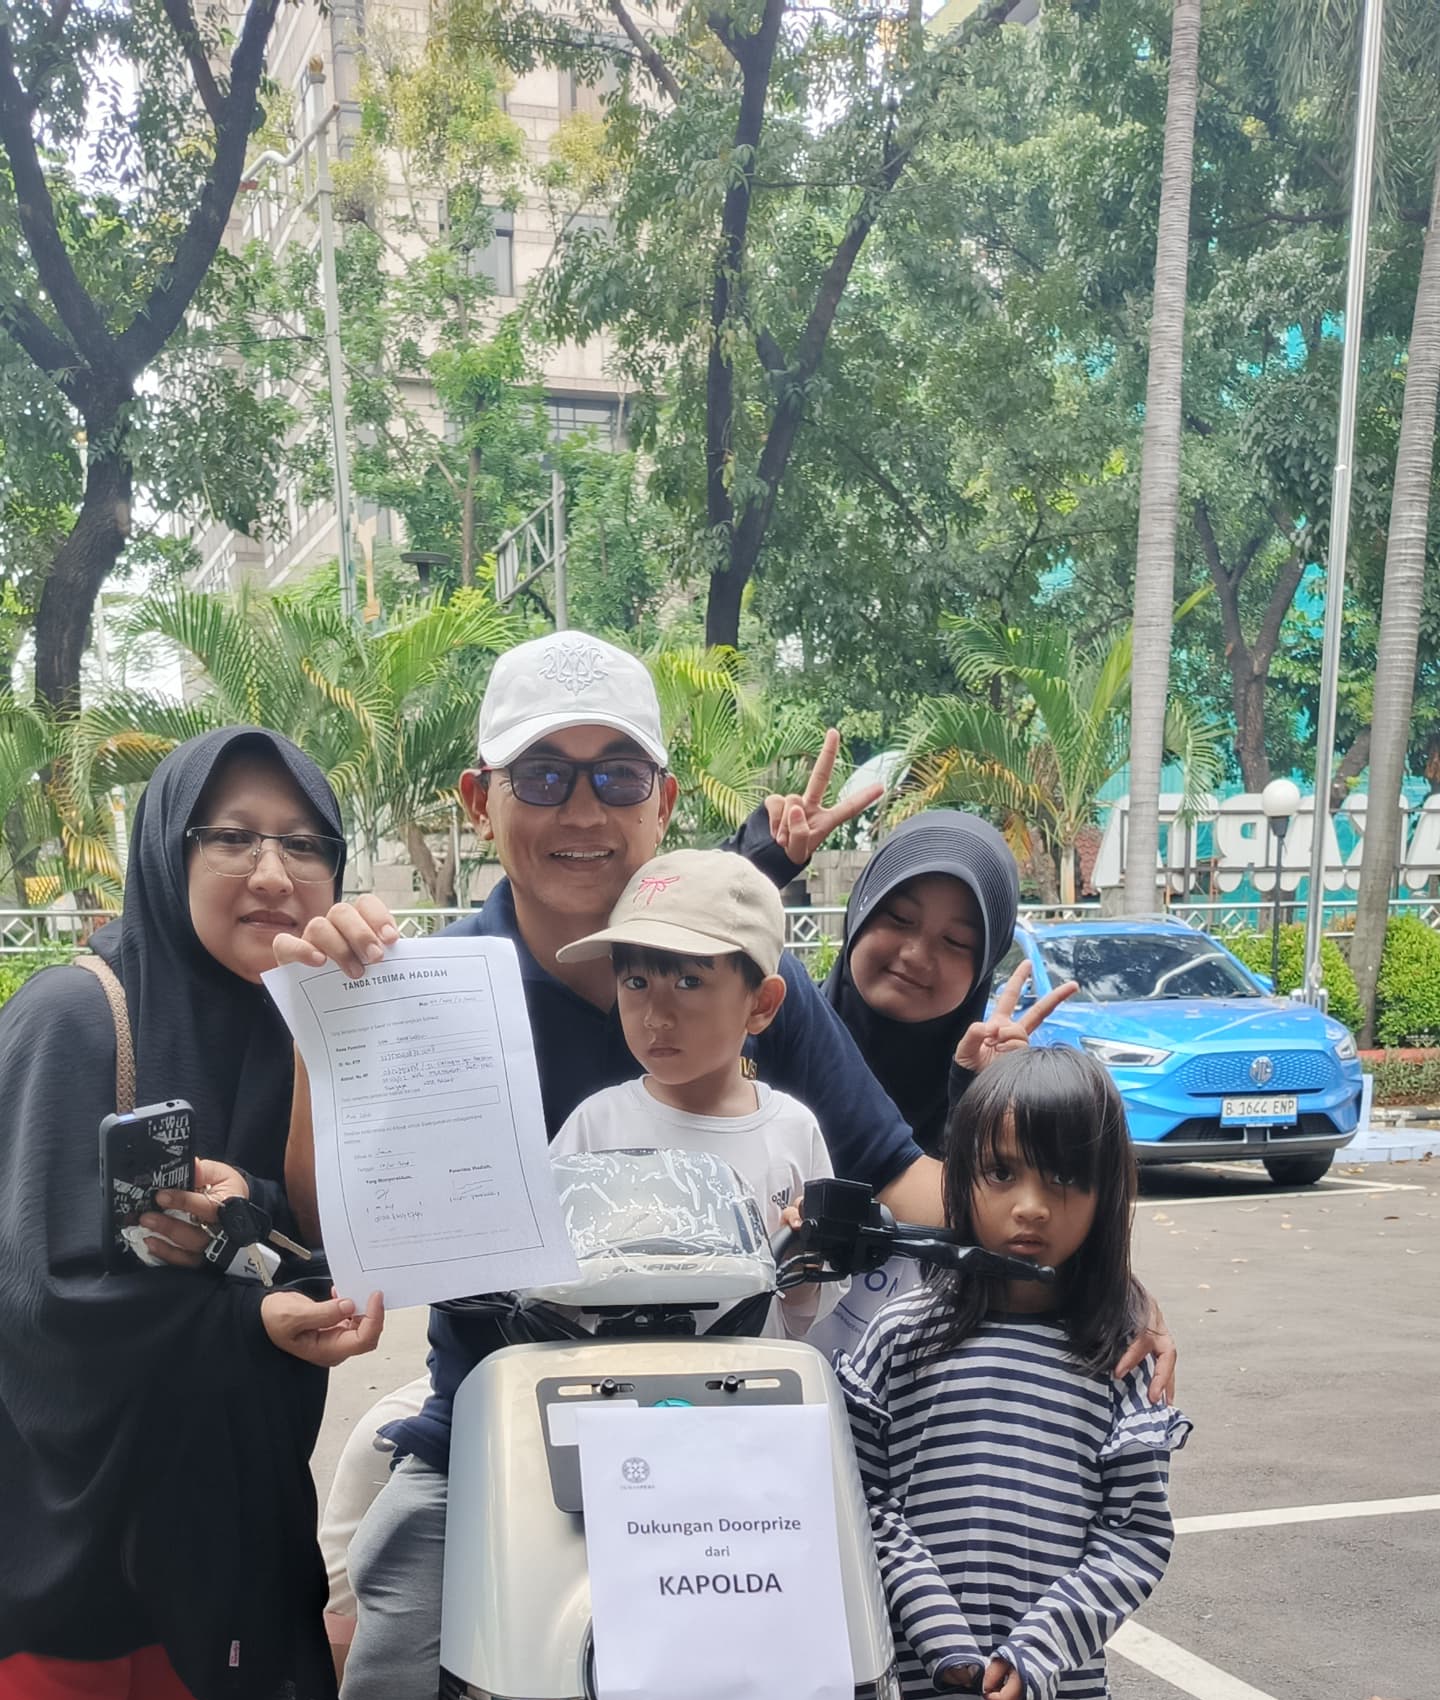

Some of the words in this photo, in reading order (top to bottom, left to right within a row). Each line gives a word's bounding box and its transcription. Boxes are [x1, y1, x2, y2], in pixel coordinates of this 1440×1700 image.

[342, 978, 371, 992] TANDA
[372, 973, 406, 986] TERIMA
[409, 969, 448, 979] HADIAH
[1226, 1102, 1233, 1116] B
[1273, 1100, 1295, 1114] ENP
[626, 1518, 713, 1537] Dukungan
[718, 1516, 802, 1534] Doorprize
[704, 1545, 731, 1558] dari
[658, 1572, 783, 1596] KAPOLDA
